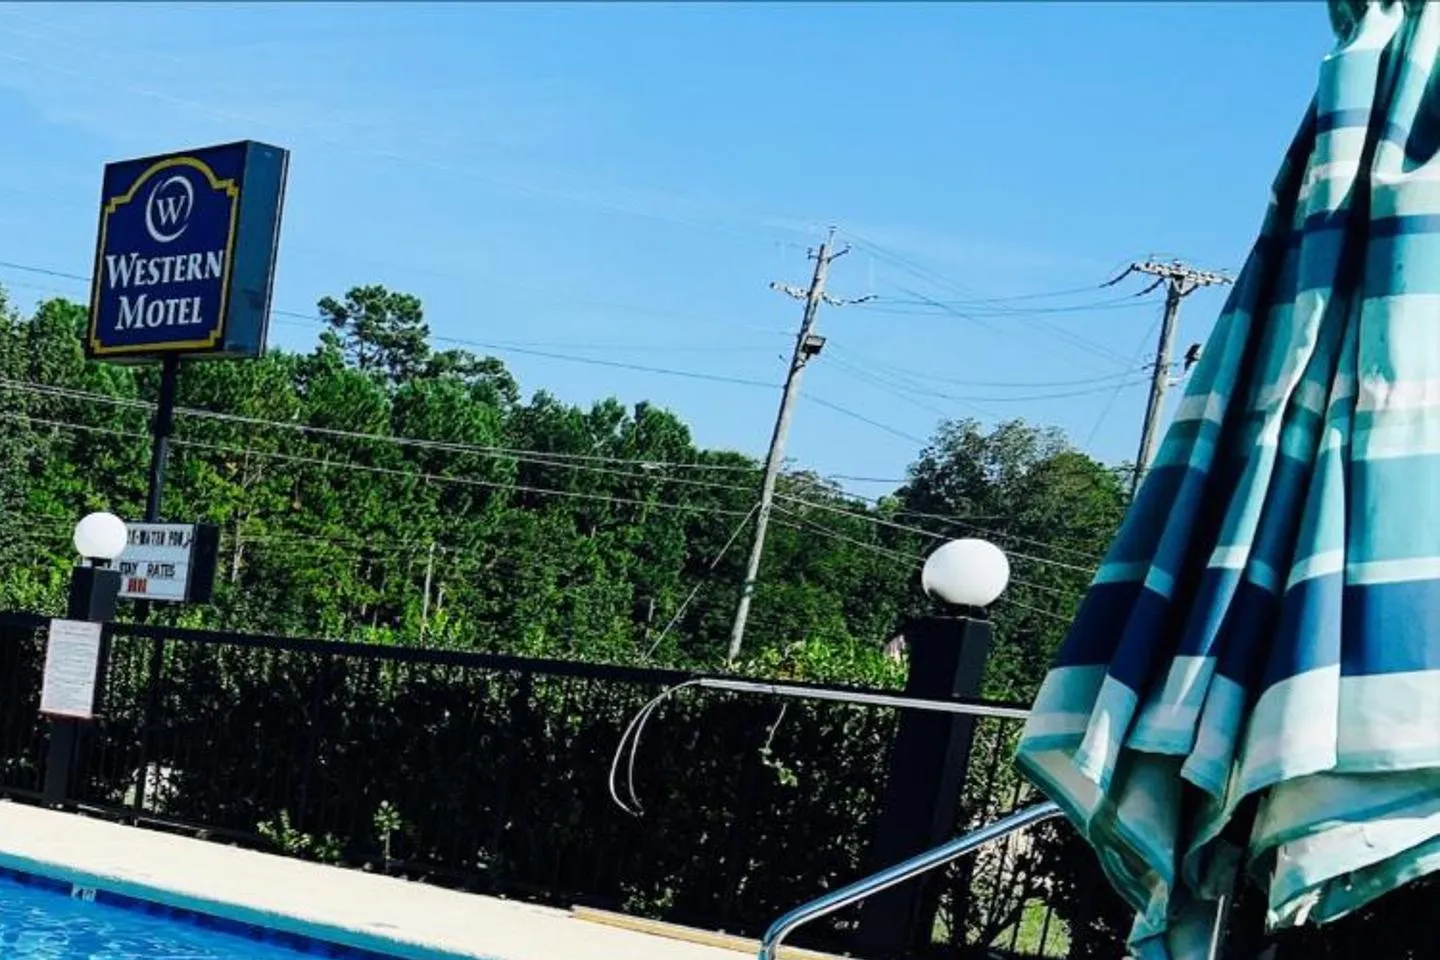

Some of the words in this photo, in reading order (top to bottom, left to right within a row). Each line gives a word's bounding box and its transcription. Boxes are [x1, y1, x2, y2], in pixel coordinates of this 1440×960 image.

[157, 195, 187, 226] W
[106, 251, 223, 289] WESTERN
[114, 293, 203, 331] MOTEL
